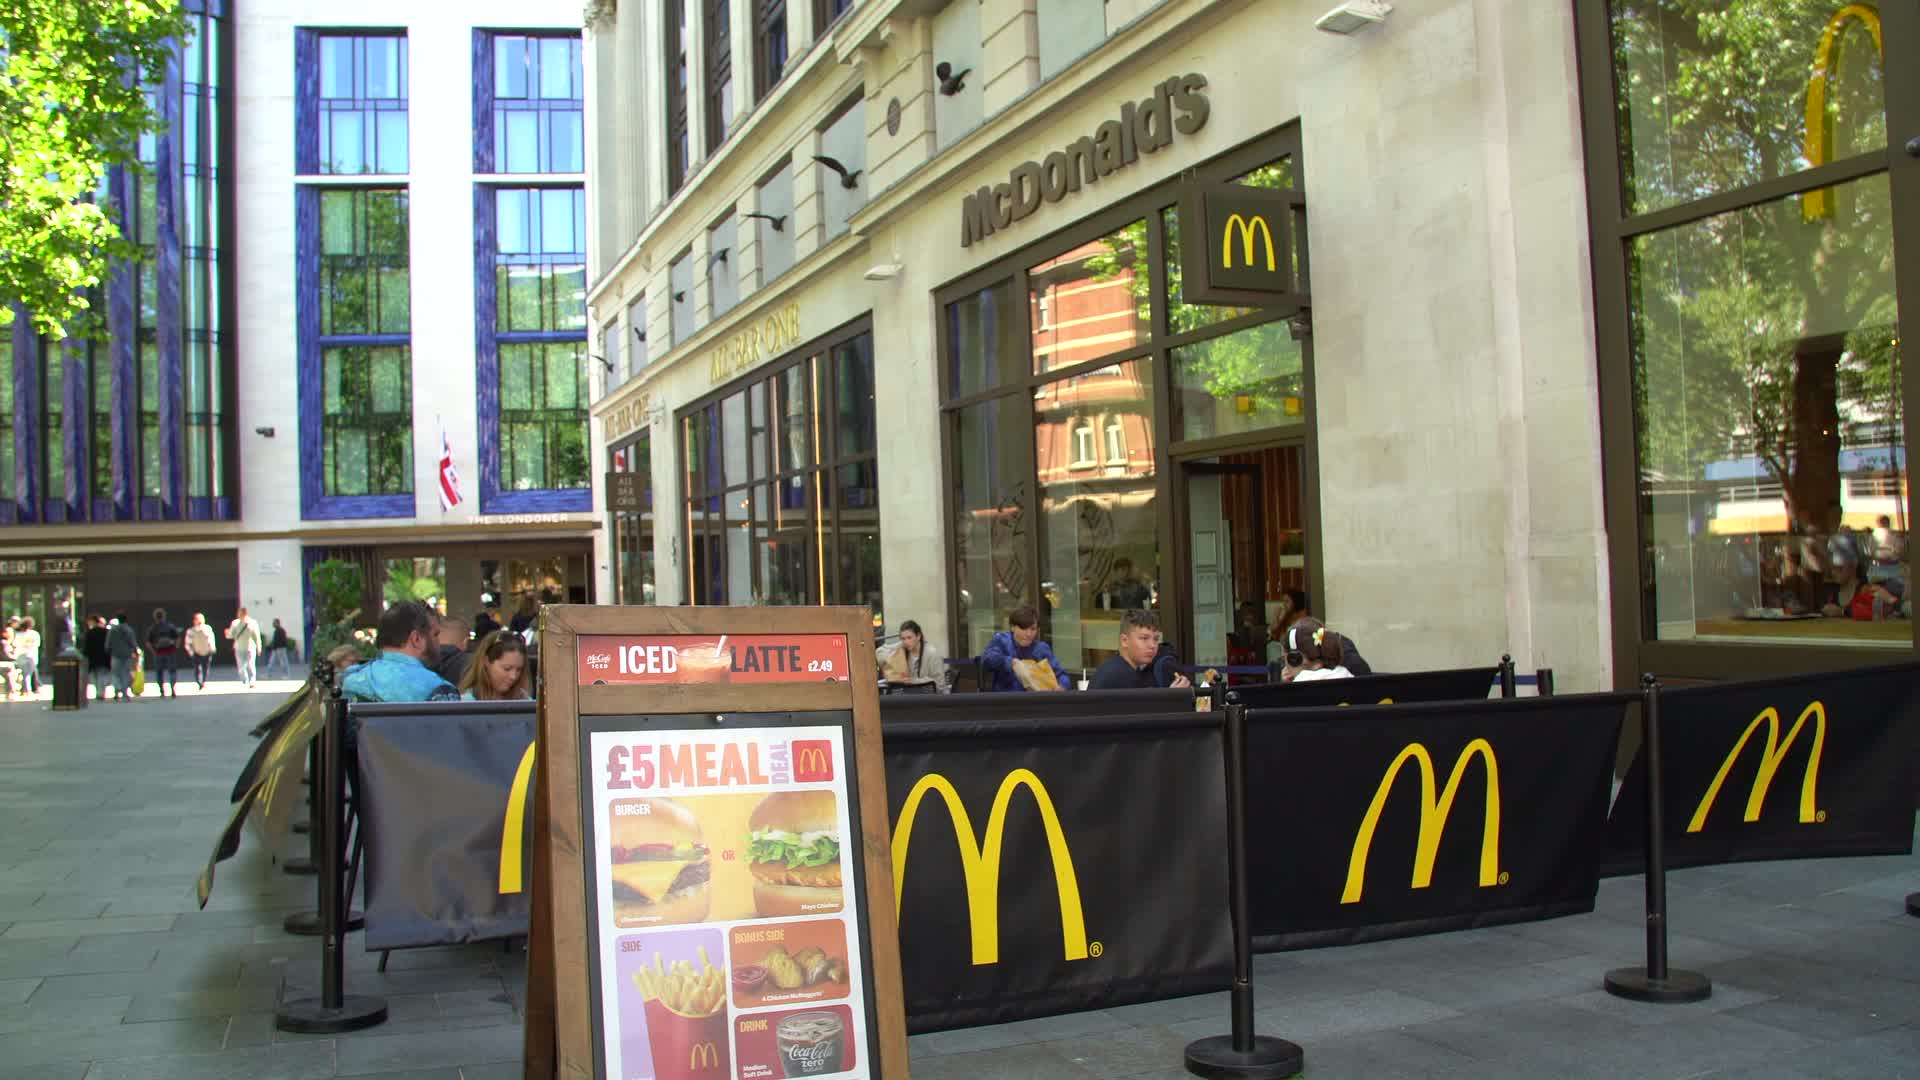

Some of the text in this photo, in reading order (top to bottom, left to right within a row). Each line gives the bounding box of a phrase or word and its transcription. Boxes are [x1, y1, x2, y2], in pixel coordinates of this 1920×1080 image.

[961, 73, 1210, 247] McDonald's
[499, 513, 568, 524] LONDONER
[619, 645, 802, 674] ICED LATTE
[808, 659, 833, 672] £2.49
[606, 740, 791, 790] £5 MEAL DEAL
[615, 803, 650, 816] BURGER
[721, 850, 736, 861] OR
[766, 930, 785, 942] SIDE
[621, 940, 642, 952] SIDE
[740, 1019, 768, 1033] DRINK
[801, 1058, 824, 1068] zero
